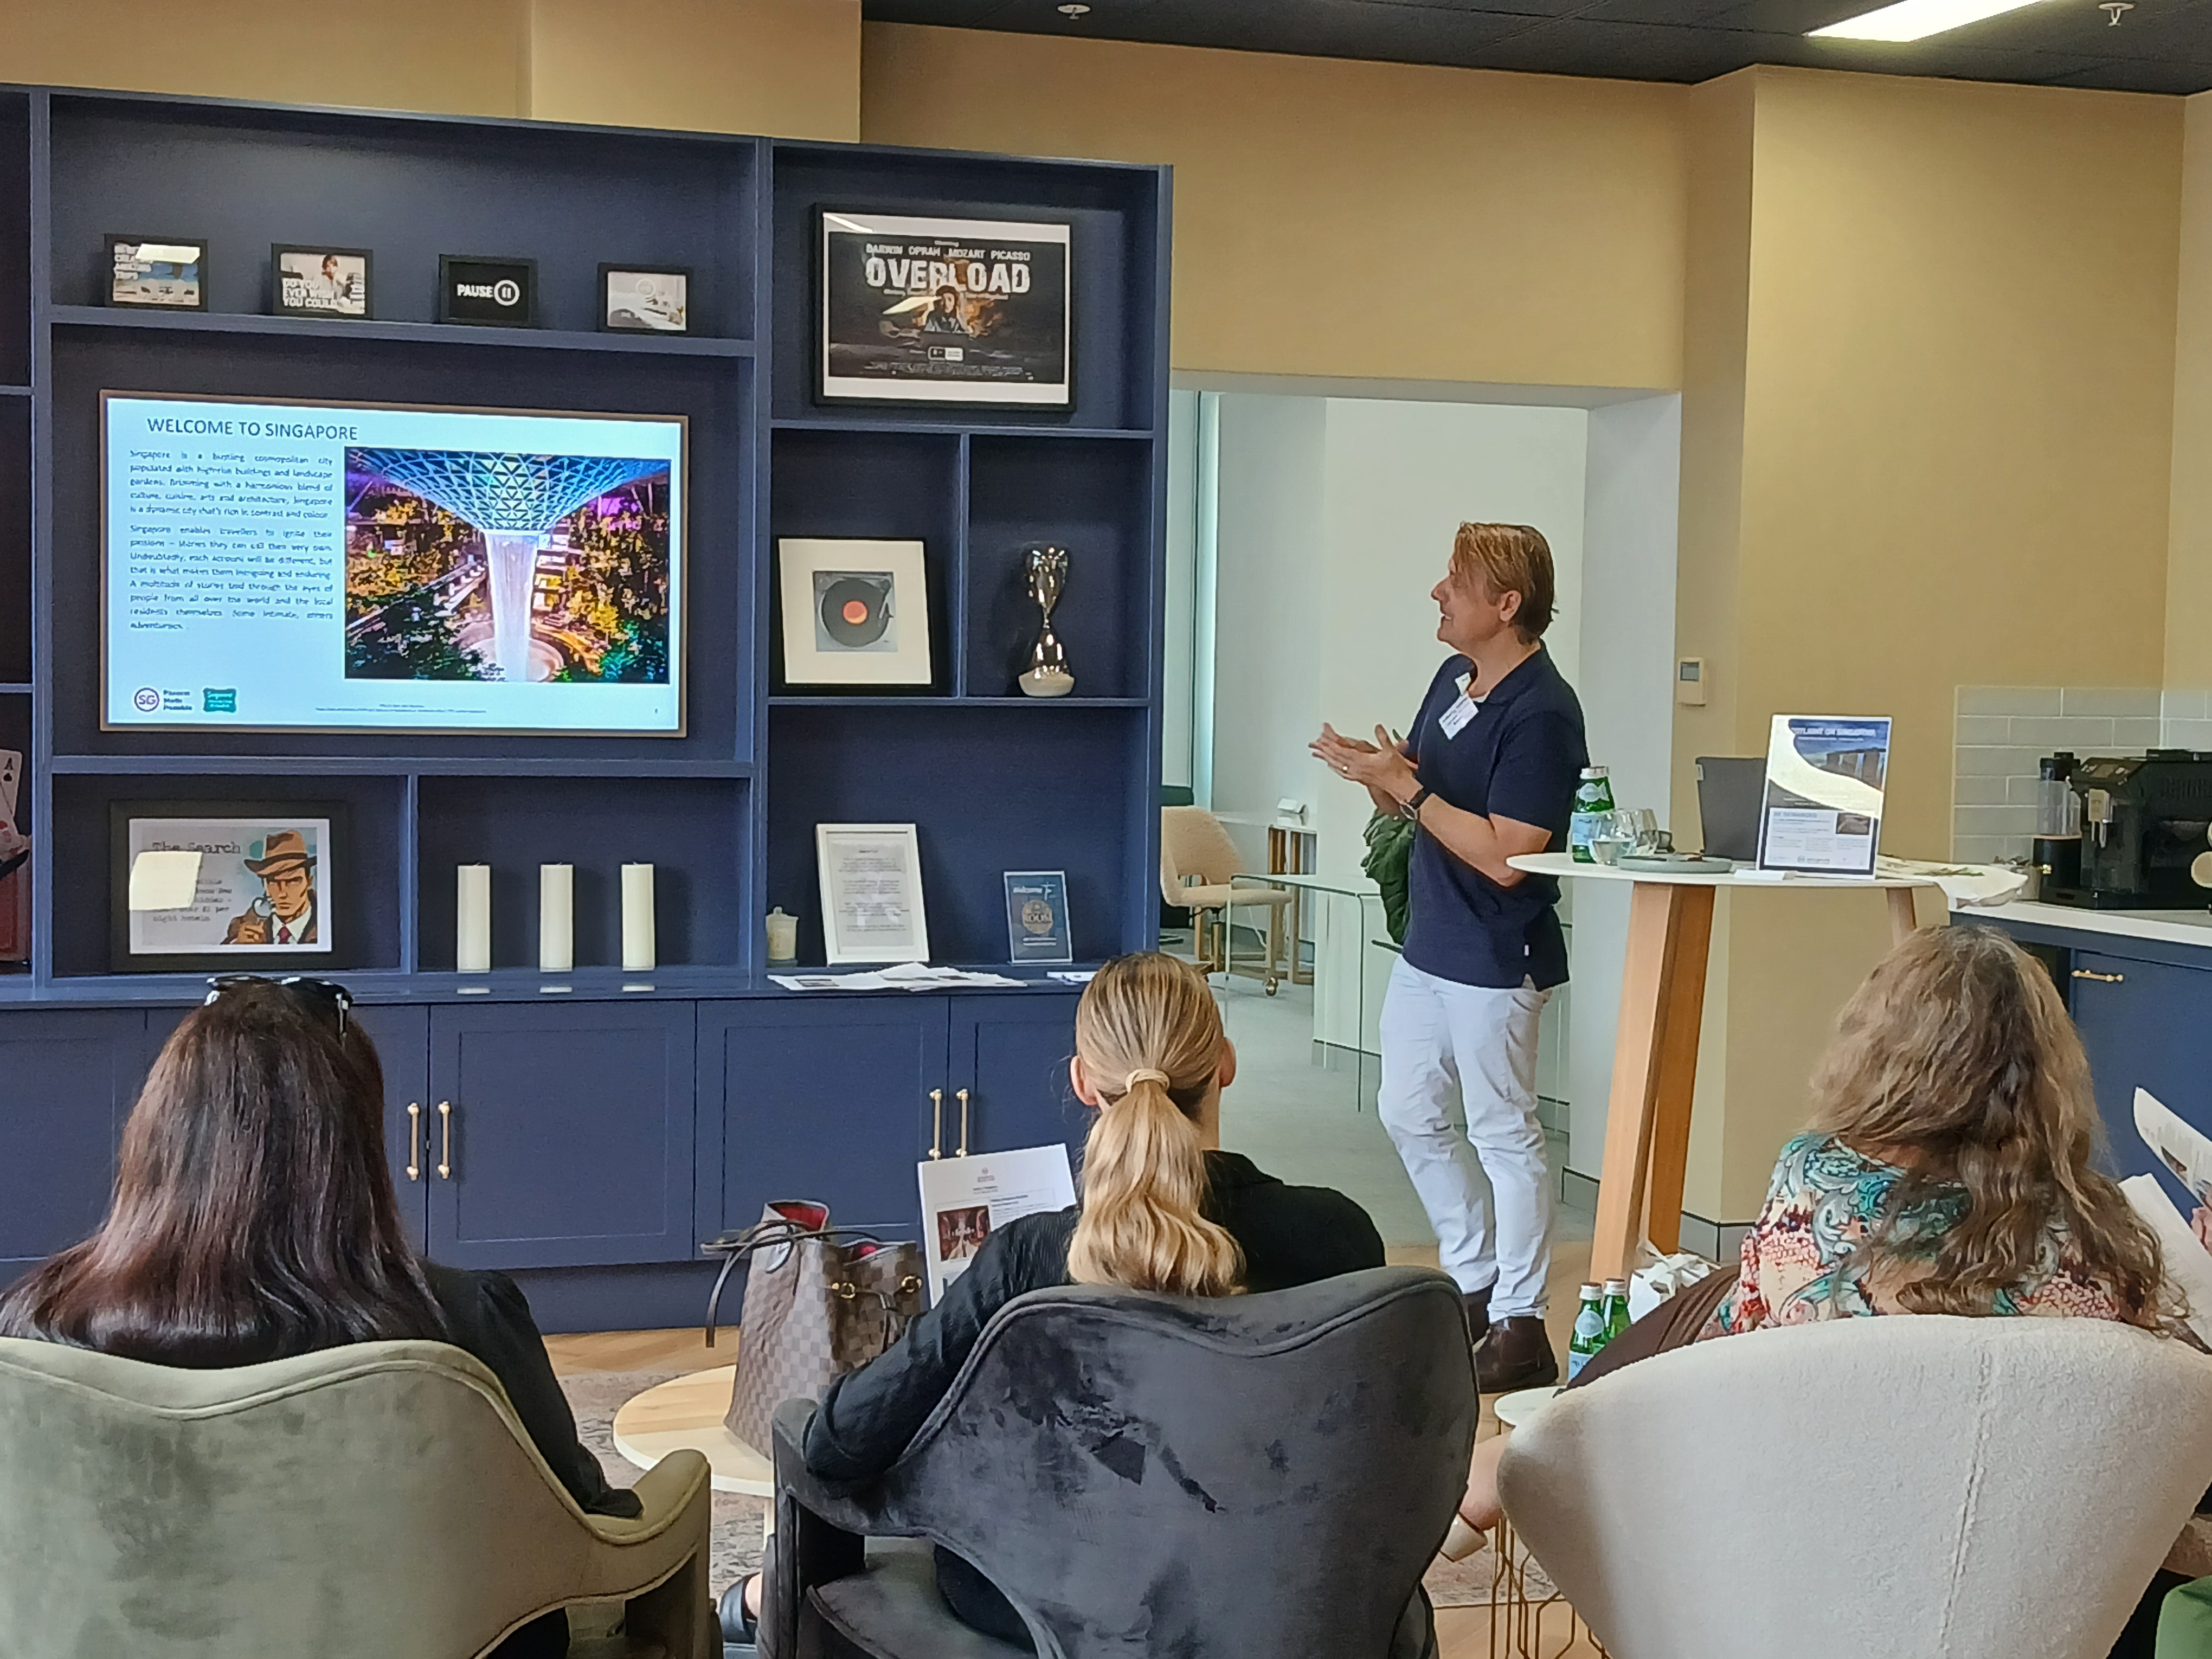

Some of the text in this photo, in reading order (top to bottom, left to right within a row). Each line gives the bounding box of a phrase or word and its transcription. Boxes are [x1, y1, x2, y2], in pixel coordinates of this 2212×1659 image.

[866, 243, 1030, 261] DARWIN OPRAH MOZART PICASSO
[865, 257, 1030, 293] OVERLOAD
[457, 284, 493, 298] PAUSE
[284, 298, 303, 307] YOU
[147, 418, 358, 440] WELCOME TO SINGAPORE
[138, 695, 156, 705] SG
[4, 757, 14, 770] A
[152, 841, 241, 854] The Search
